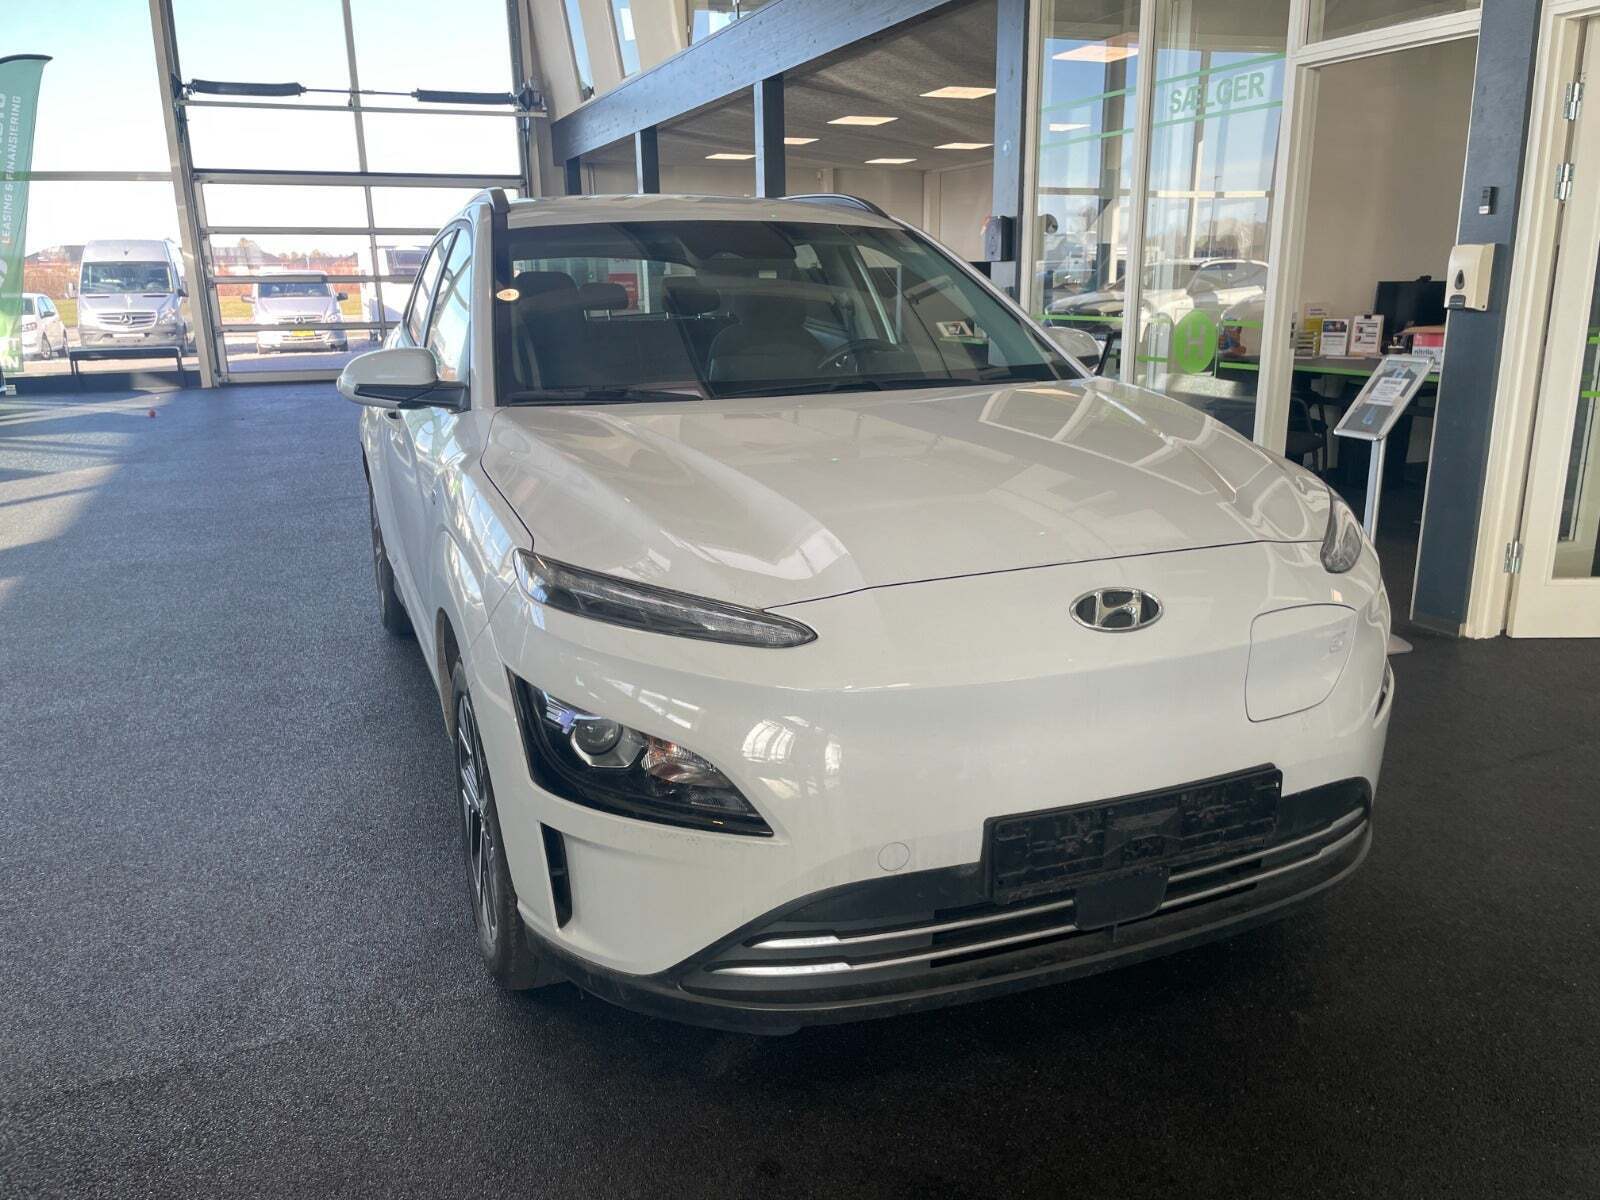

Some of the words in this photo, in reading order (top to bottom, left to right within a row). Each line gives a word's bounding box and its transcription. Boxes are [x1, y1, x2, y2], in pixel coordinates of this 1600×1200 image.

[1170, 72, 1265, 113] SÆLGER
[6, 95, 22, 180] FINANSIERING
[5, 183, 13, 192] &
[2, 193, 13, 244] LEASING
